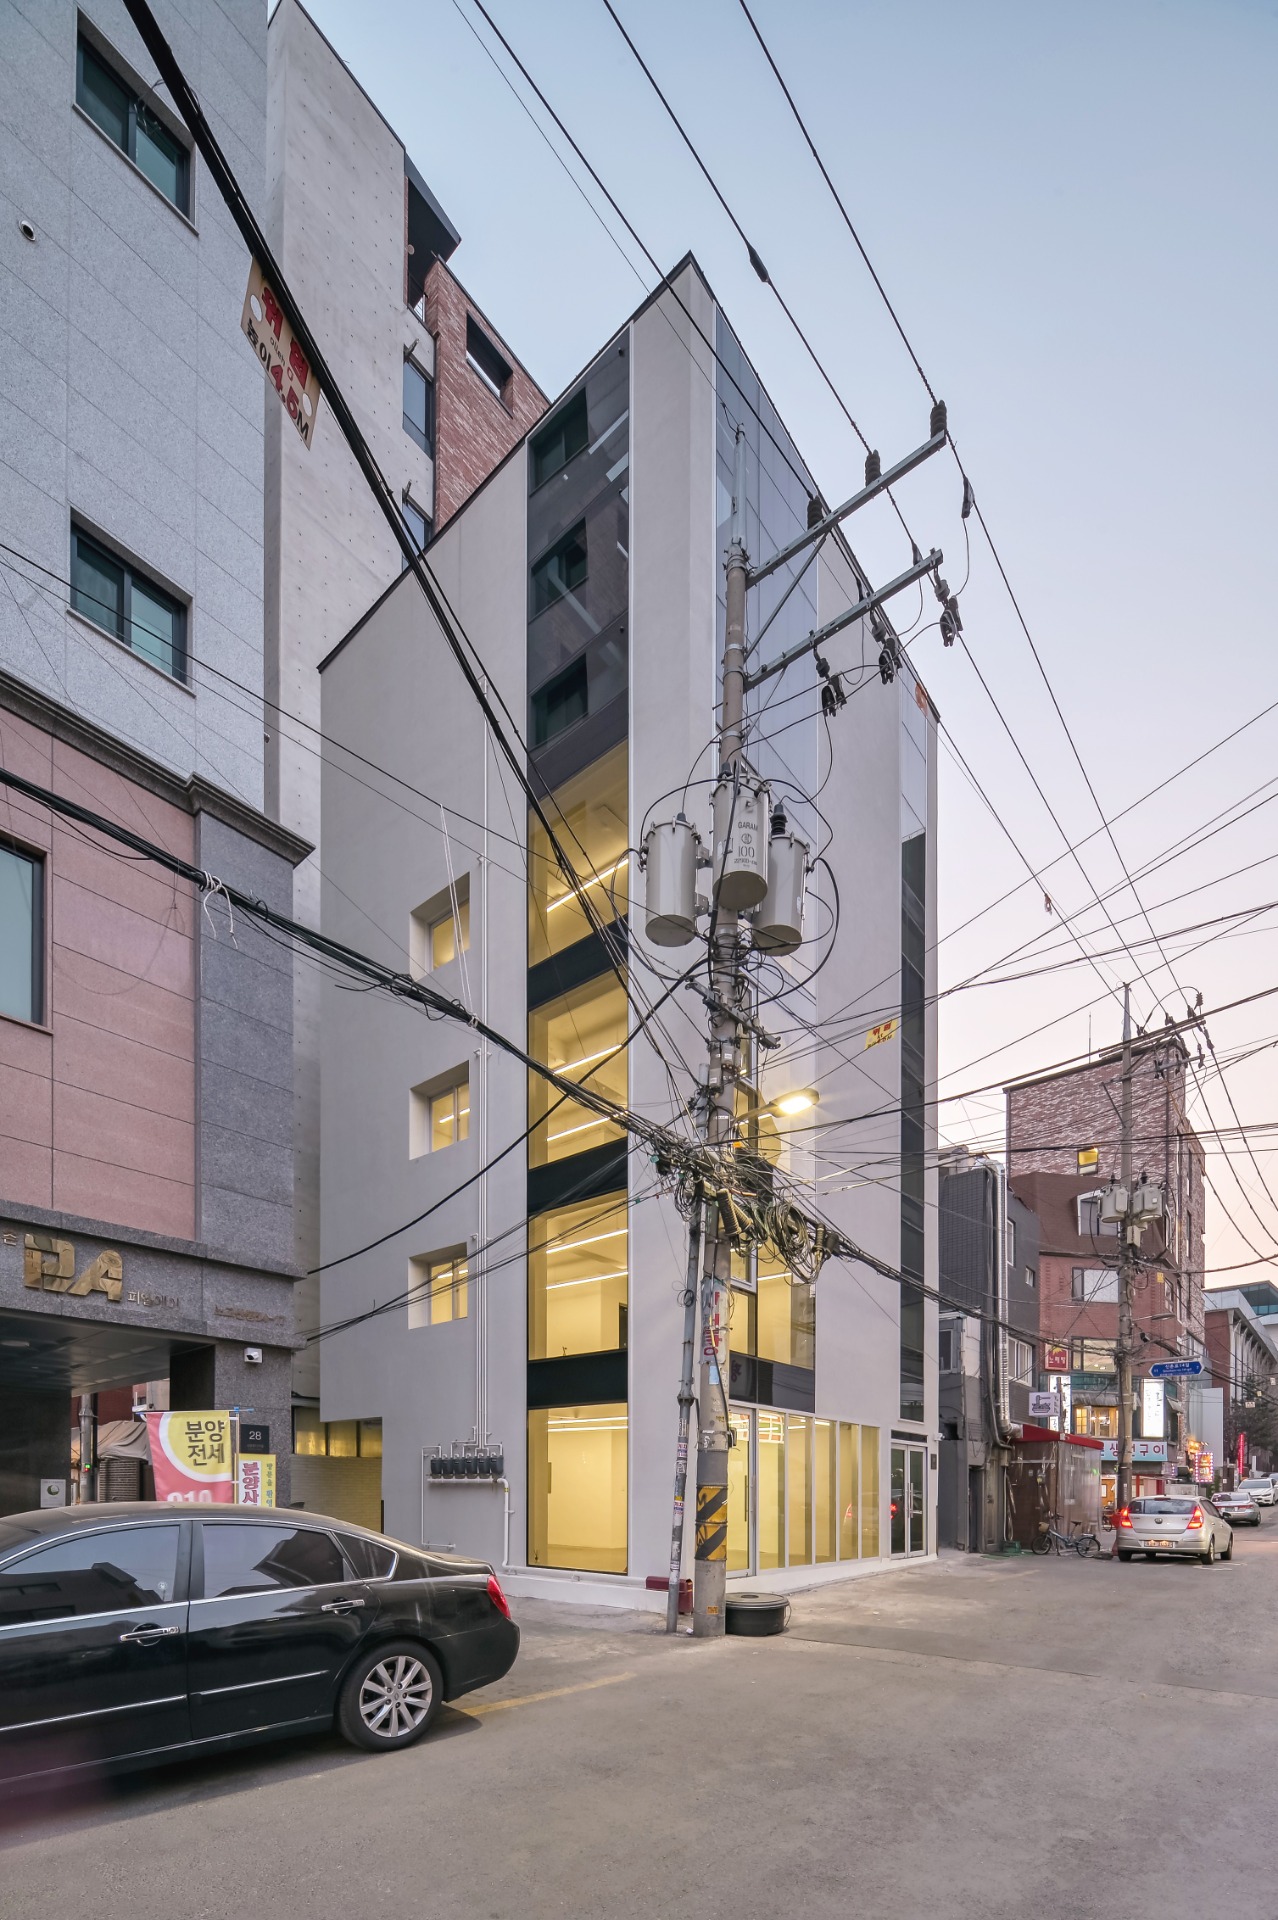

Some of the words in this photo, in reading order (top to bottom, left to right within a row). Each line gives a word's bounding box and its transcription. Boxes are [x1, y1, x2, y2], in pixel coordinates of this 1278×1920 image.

[738, 845, 755, 858] 100
[185, 1420, 225, 1443] 분양
[248, 1430, 262, 1441] 28
[188, 1443, 225, 1467] 전세
[242, 1461, 260, 1505] 분양사
